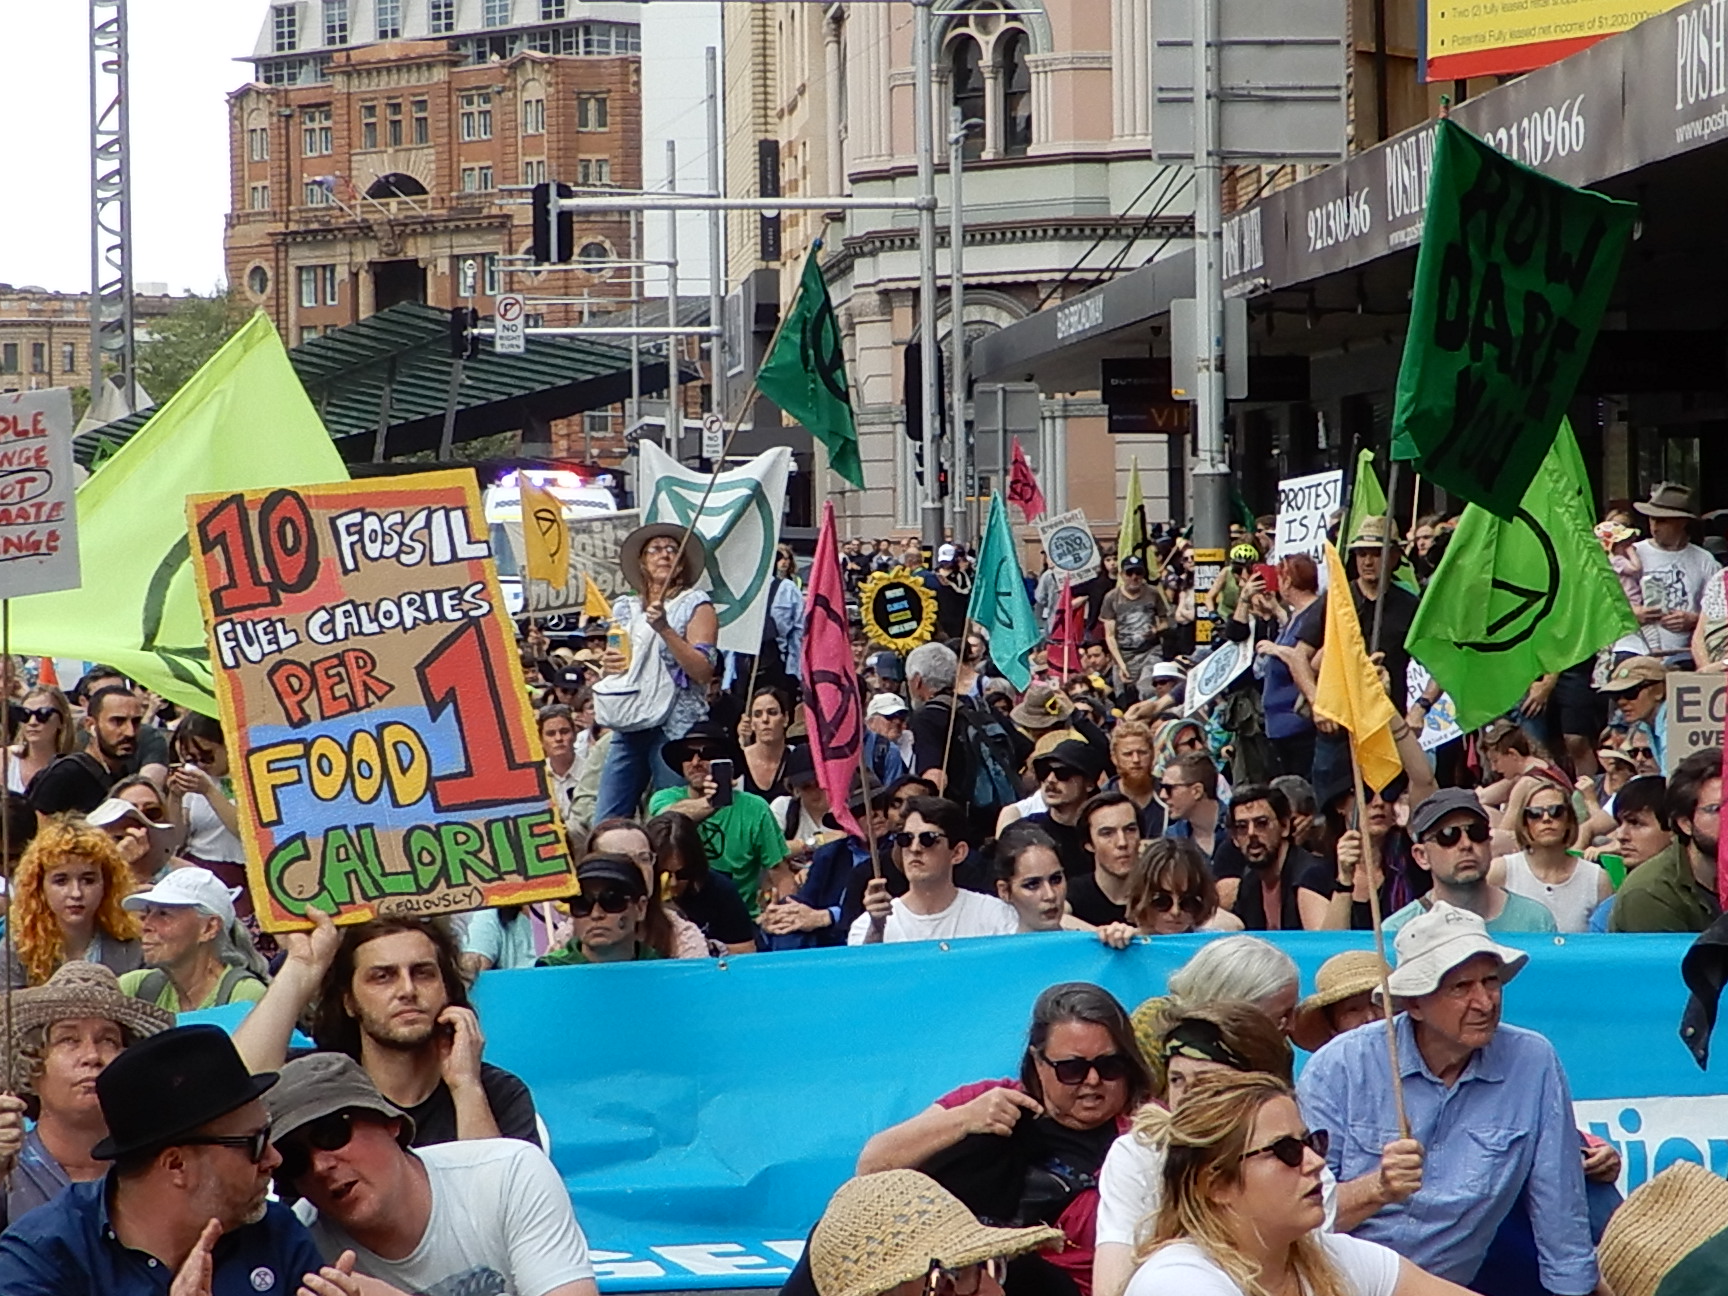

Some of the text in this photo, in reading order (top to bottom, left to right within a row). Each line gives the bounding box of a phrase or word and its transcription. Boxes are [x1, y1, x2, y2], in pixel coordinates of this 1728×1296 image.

[1451, 30, 1487, 47] Potential
[1509, 24, 1537, 41] leased
[1554, 18, 1585, 34] income
[1452, 6, 1471, 19] Two
[1307, 186, 1371, 253] 92130966
[1385, 135, 1419, 222] POSH
[1459, 166, 1610, 296] HOW
[501, 323, 519, 333] NO
[1434, 241, 1580, 422] DARE
[1279, 478, 1341, 513] PROTEST
[1284, 511, 1330, 544] IS A
[195, 487, 492, 617] 10 FOSSIL
[212, 611, 299, 670] FUEL
[305, 581, 494, 646] CALORIES
[267, 617, 553, 814] PER 1
[1688, 729, 1726, 747] OVE
[245, 722, 432, 829] FOOD
[263, 810, 570, 918] CALORIE
